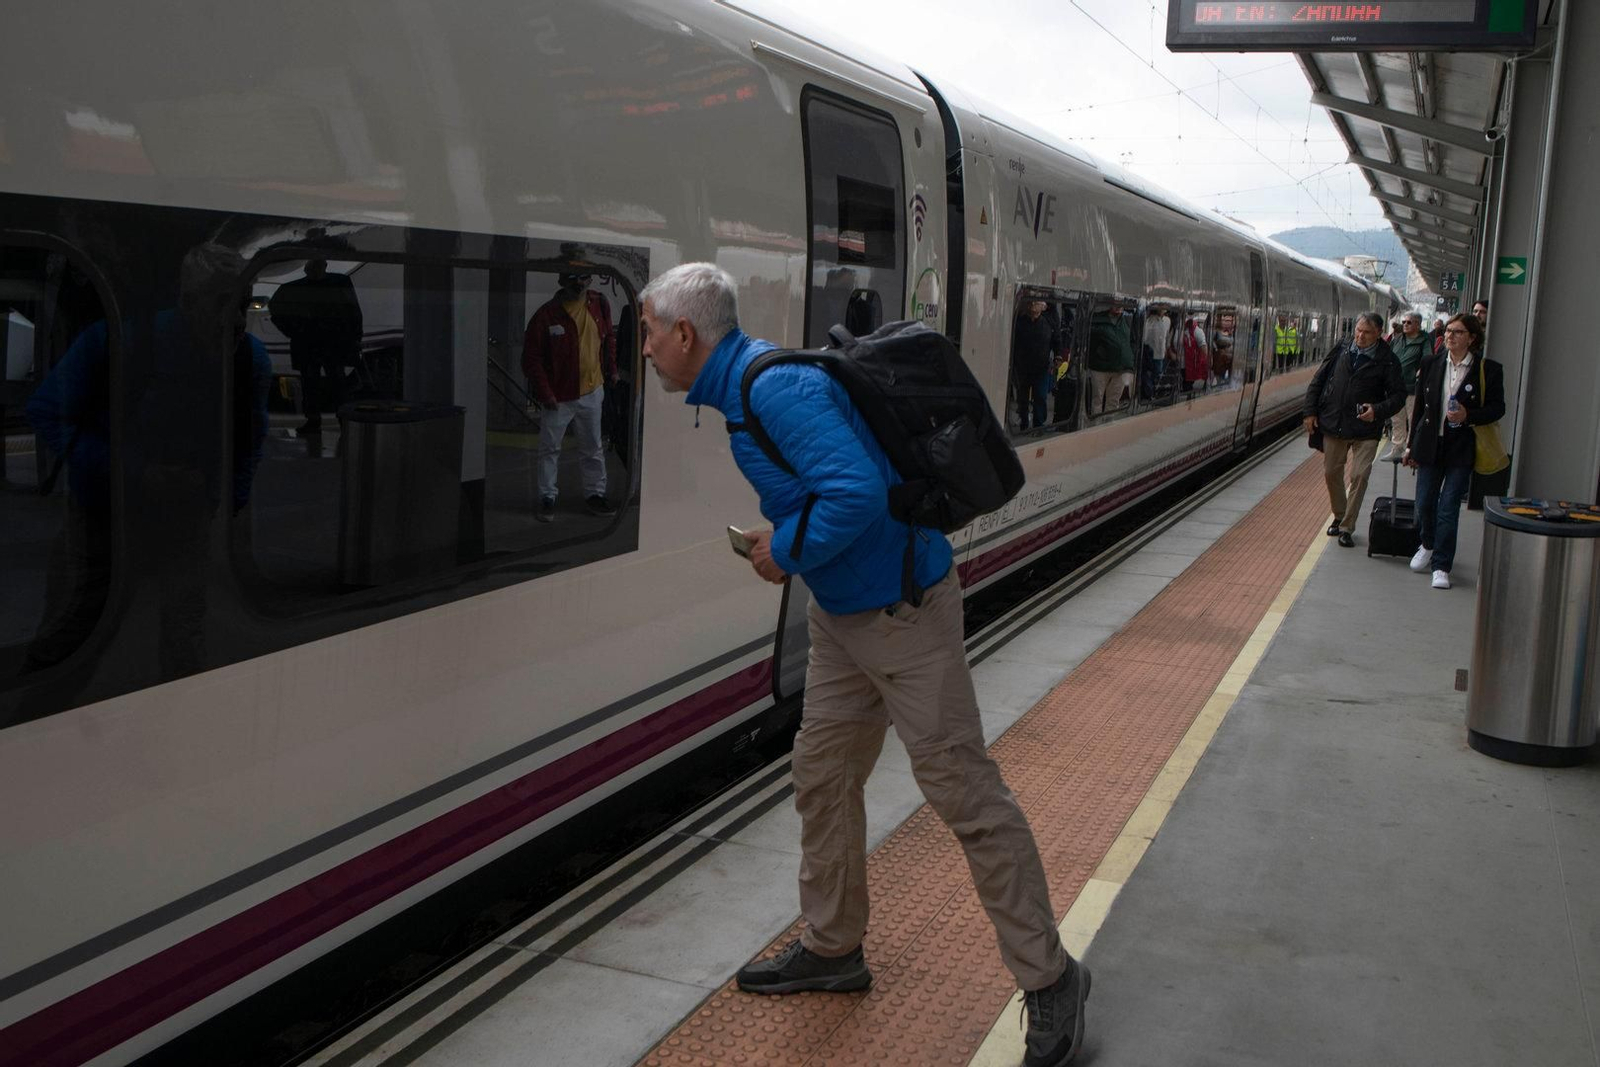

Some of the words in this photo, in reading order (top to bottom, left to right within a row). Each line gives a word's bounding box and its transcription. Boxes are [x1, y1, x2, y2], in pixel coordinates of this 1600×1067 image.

[1013, 185, 1057, 241] AVE
[1442, 281, 1448, 290] 5
[1451, 282, 1458, 291] A
